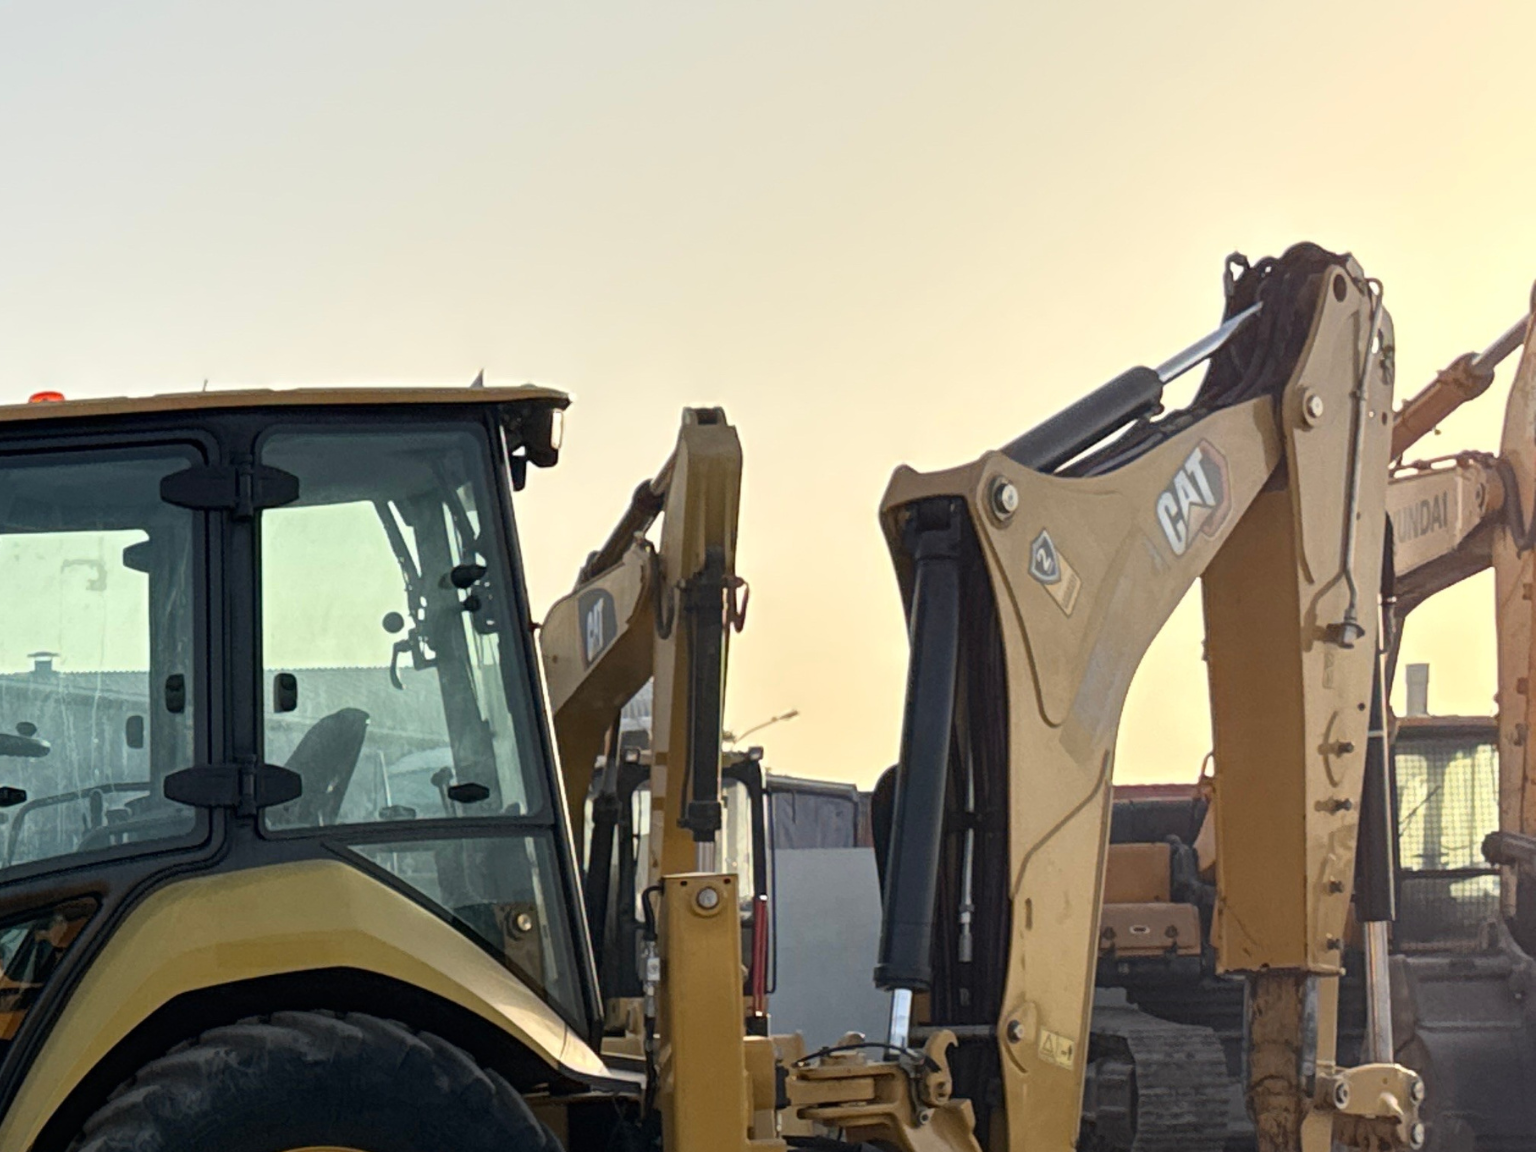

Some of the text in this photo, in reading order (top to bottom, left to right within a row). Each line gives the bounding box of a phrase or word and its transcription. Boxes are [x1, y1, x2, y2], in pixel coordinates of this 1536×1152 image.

[1157, 447, 1216, 555] CAT
[1394, 491, 1447, 543] UNDAI
[1037, 548, 1052, 574] 2
